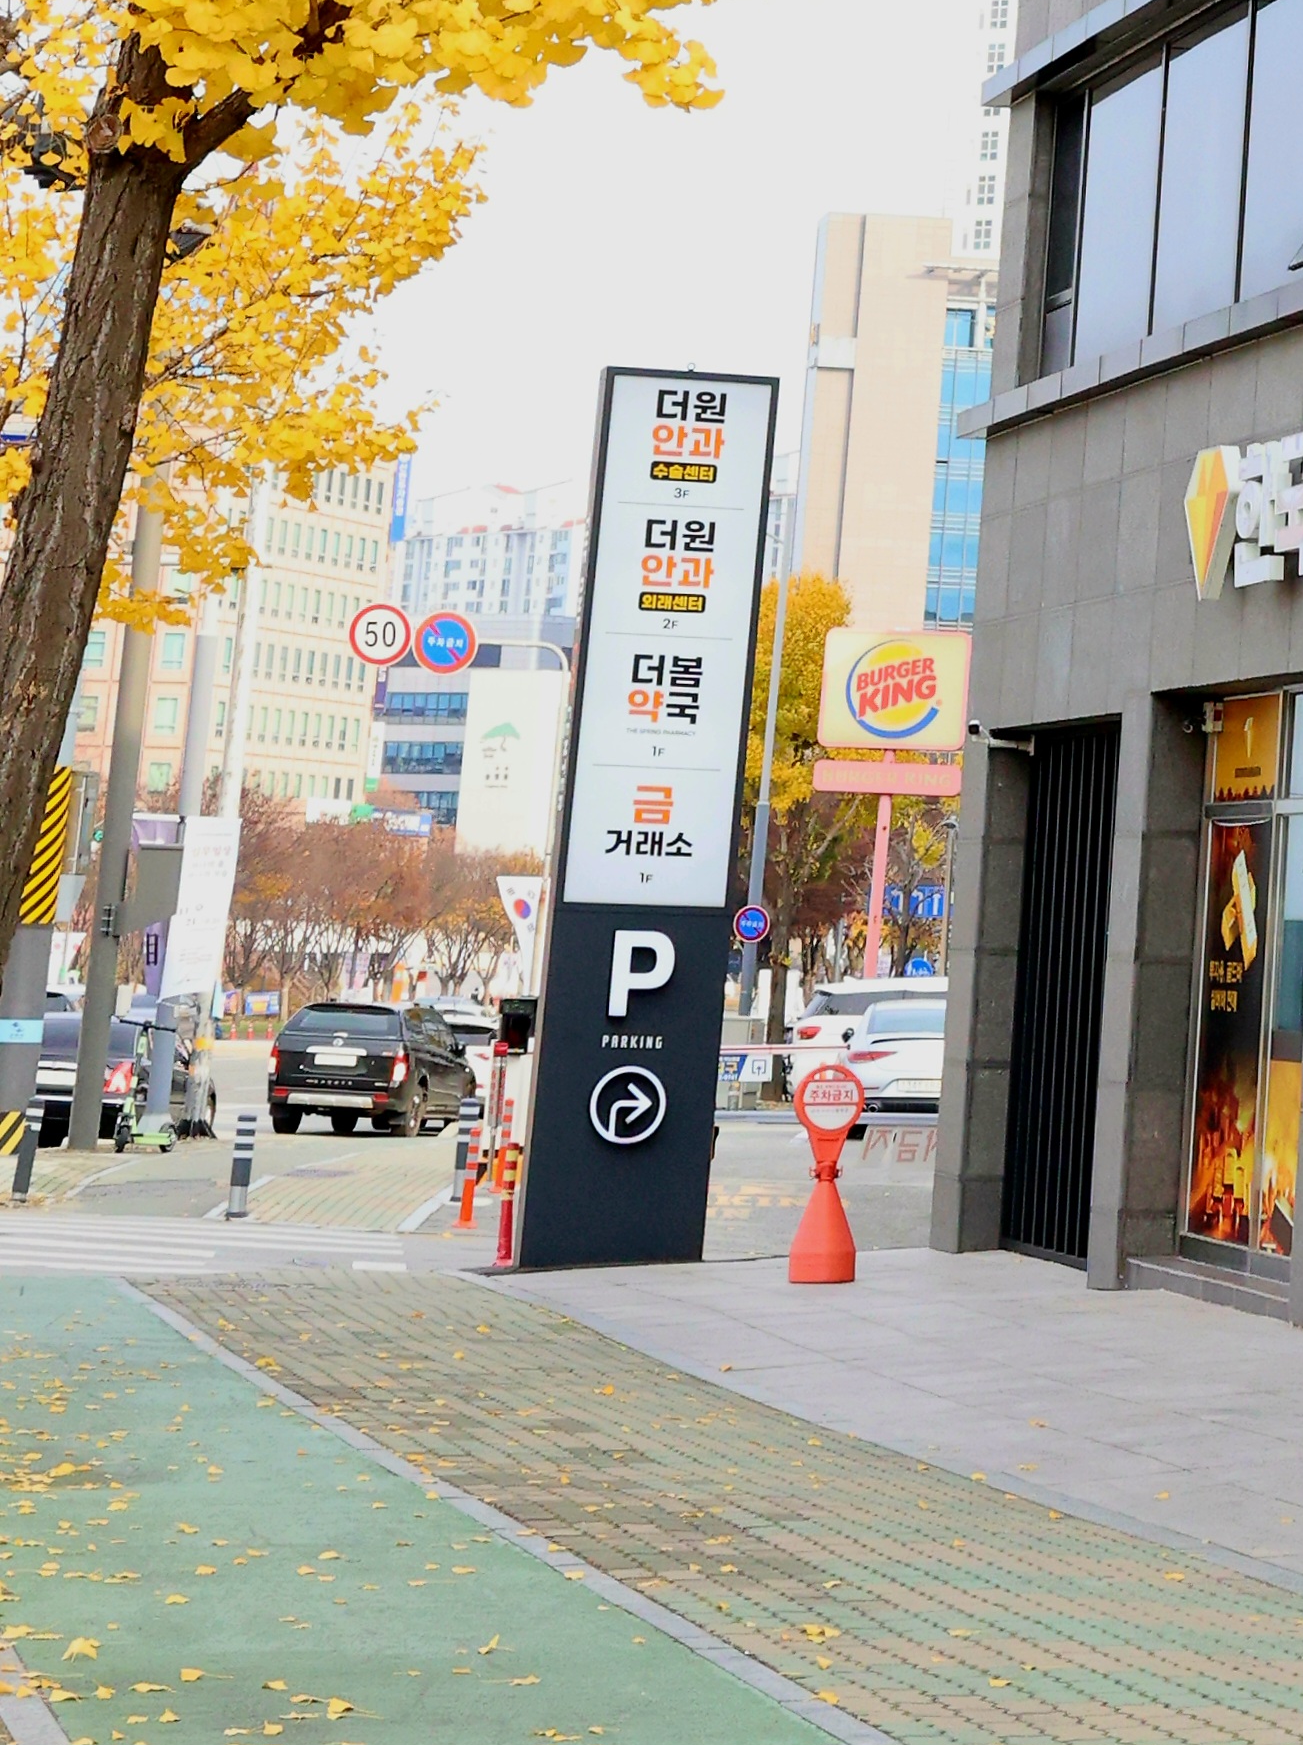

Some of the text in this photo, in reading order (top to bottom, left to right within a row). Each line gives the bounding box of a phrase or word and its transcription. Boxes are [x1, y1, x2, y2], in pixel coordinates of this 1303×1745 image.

[656, 389, 727, 423] 더원
[652, 424, 724, 459] 안과
[653, 463, 714, 482] 수술센터
[674, 488, 690, 498] 3F
[644, 519, 716, 552] 더원
[641, 555, 714, 588] 안과
[641, 593, 703, 612] 외래센터
[364, 621, 397, 648] 50
[663, 619, 678, 629] 2F
[631, 654, 703, 688] 더봄
[856, 657, 935, 693] BURGER
[627, 689, 700, 724] 약국
[858, 675, 938, 719] KING
[652, 746, 665, 756] 1F
[821, 769, 898, 786] BURGER
[904, 771, 952, 788] KING
[633, 785, 674, 825] 금
[605, 829, 693, 857] 거래소
[640, 872, 653, 883] 1F
[607, 929, 677, 1018] P
[601, 1035, 664, 1050] PARKING
[810, 1089, 854, 1102] 주차금지
